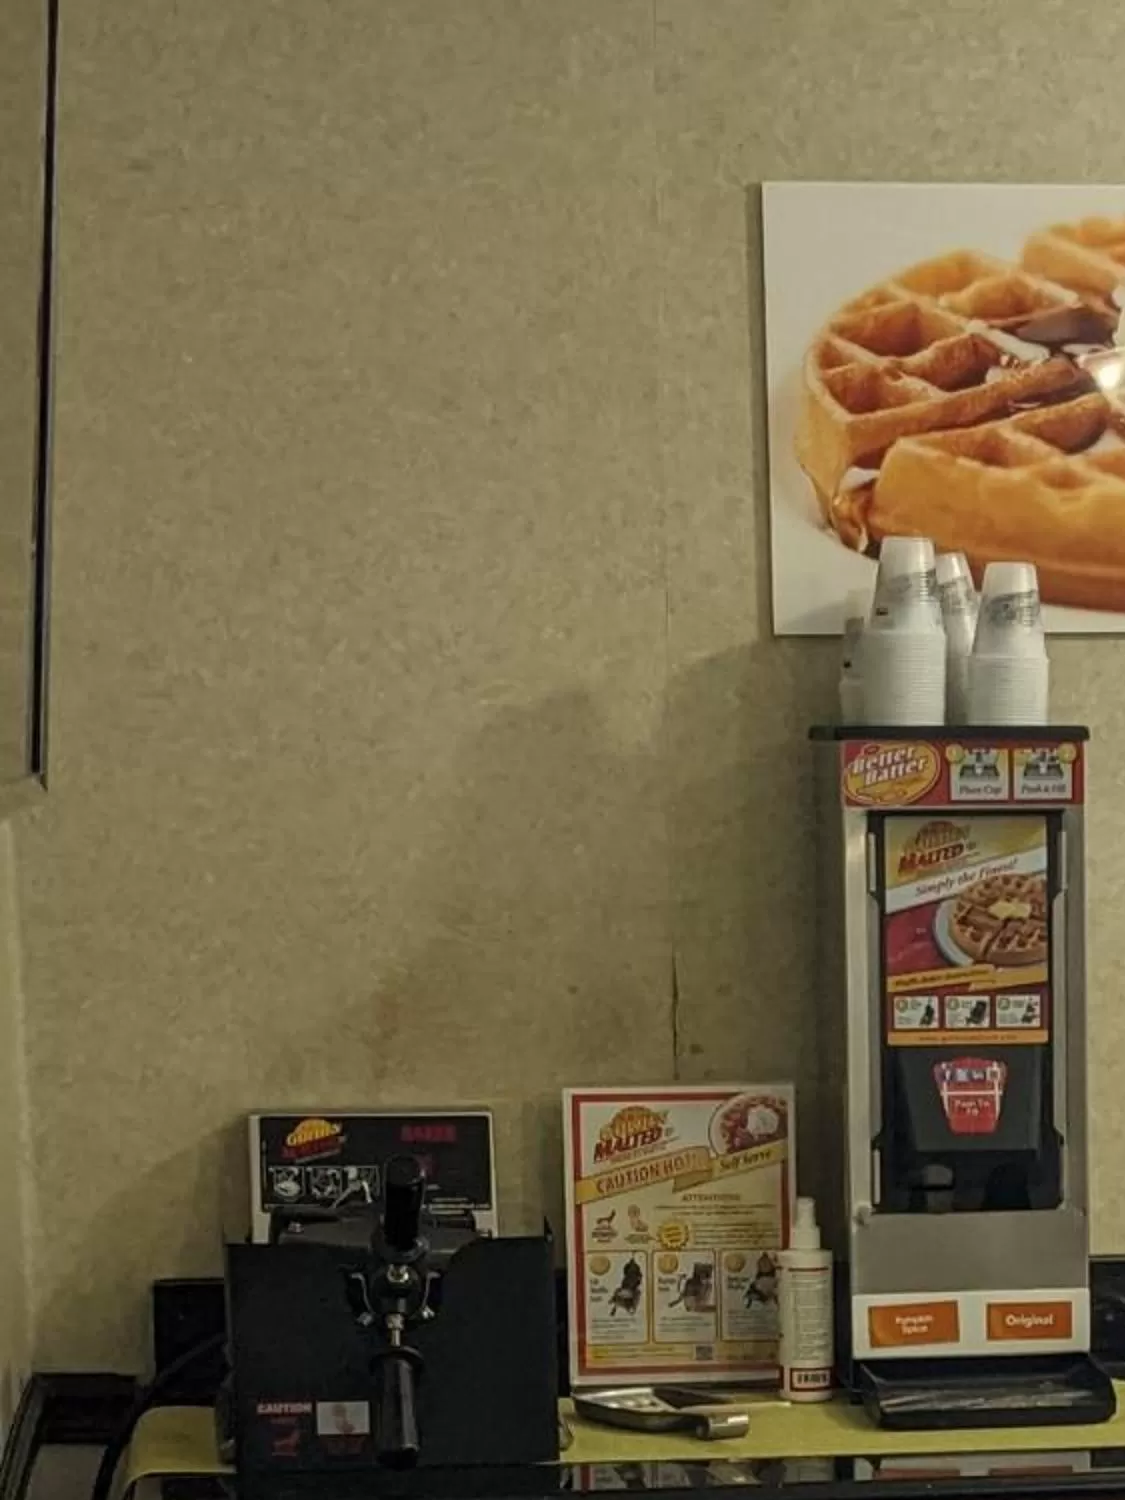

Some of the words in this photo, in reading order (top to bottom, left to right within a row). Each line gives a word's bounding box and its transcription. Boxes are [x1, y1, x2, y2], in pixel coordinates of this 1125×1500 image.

[848, 746, 917, 774] Better
[863, 757, 927, 786] Batter
[593, 1126, 664, 1165] MALTED
[595, 1162, 660, 1194] CAUTION
[1004, 1313, 1054, 1328] Original
[256, 1401, 313, 1415] CAUTION
